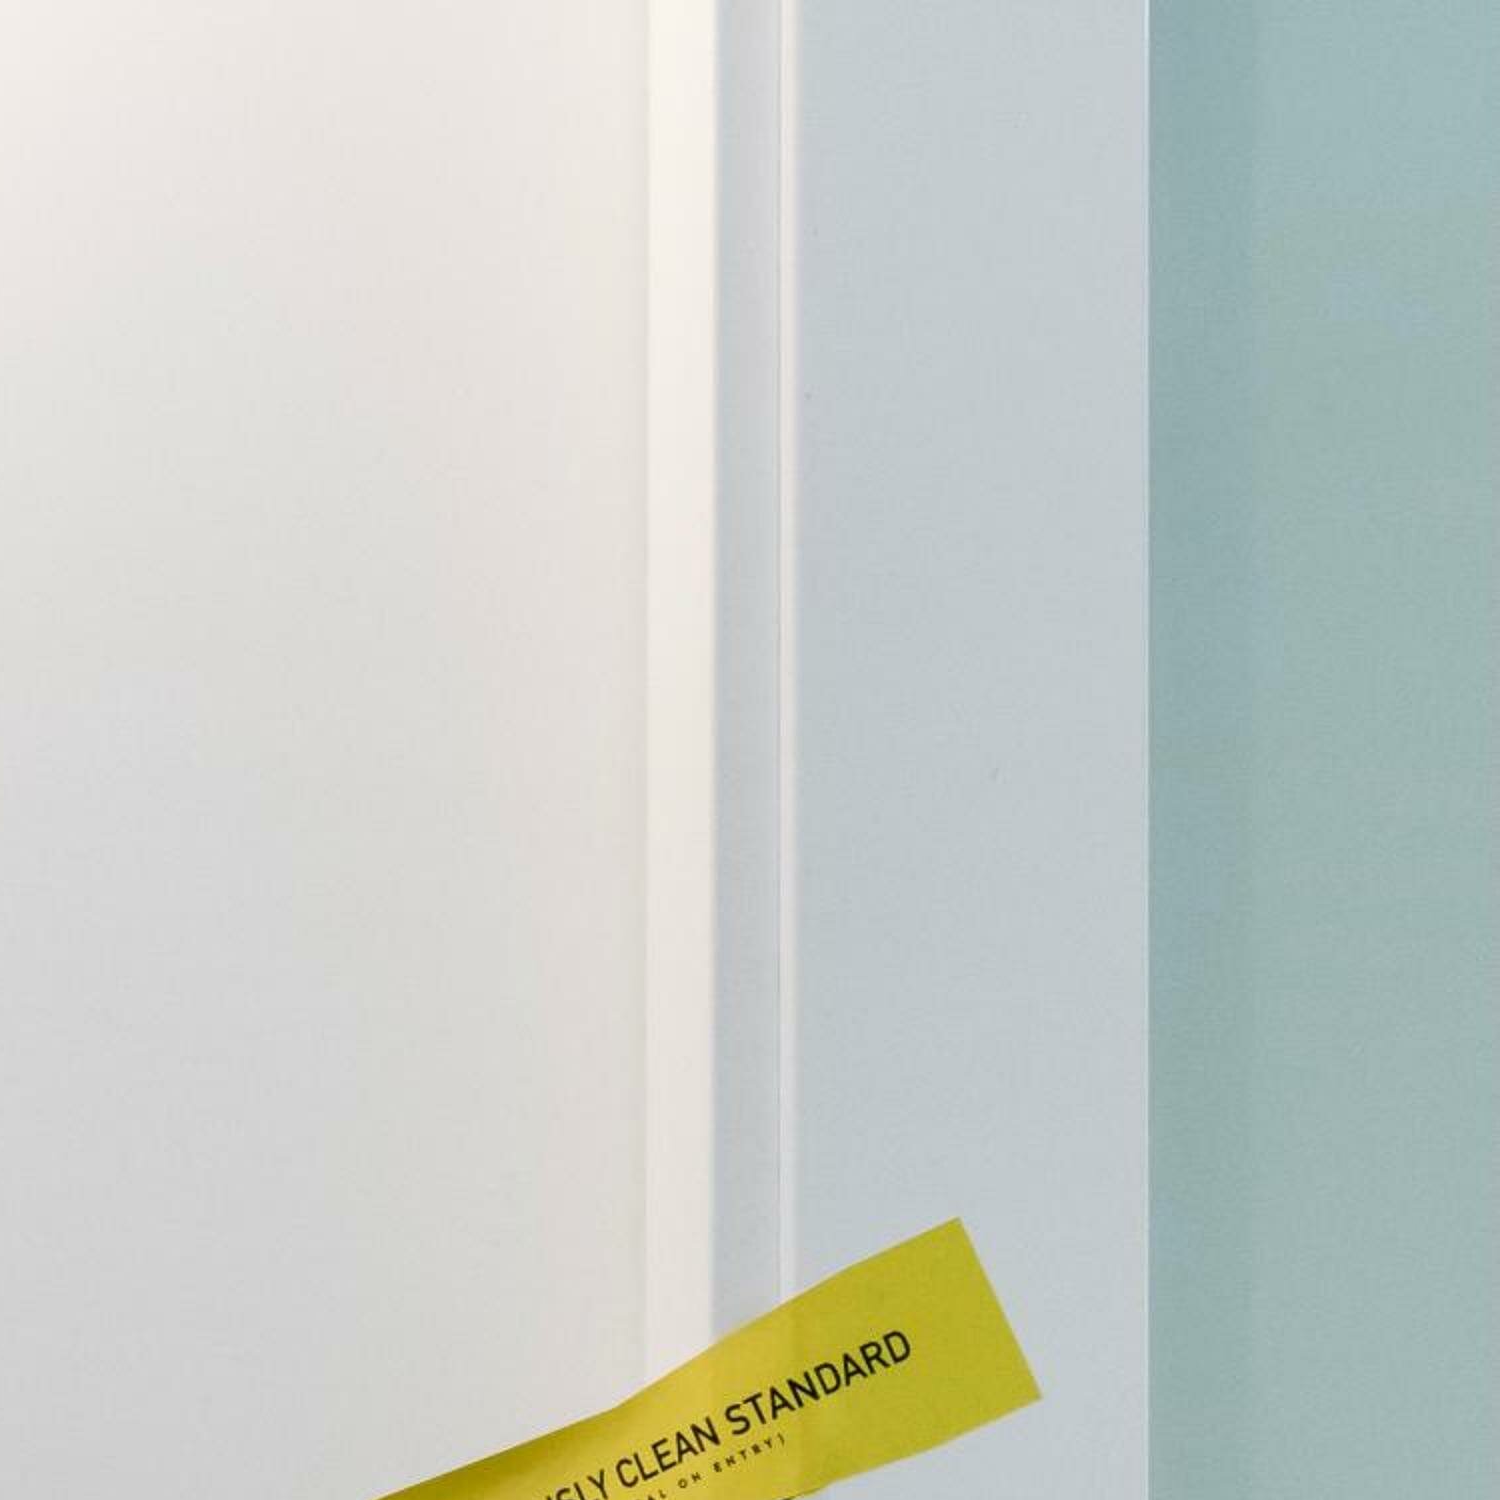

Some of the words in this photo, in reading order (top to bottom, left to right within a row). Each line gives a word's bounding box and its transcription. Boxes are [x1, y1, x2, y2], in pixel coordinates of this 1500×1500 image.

[615, 1416, 722, 1489] CLEAN
[724, 1330, 912, 1436] STANDARD
[677, 1471, 702, 1489] ON
